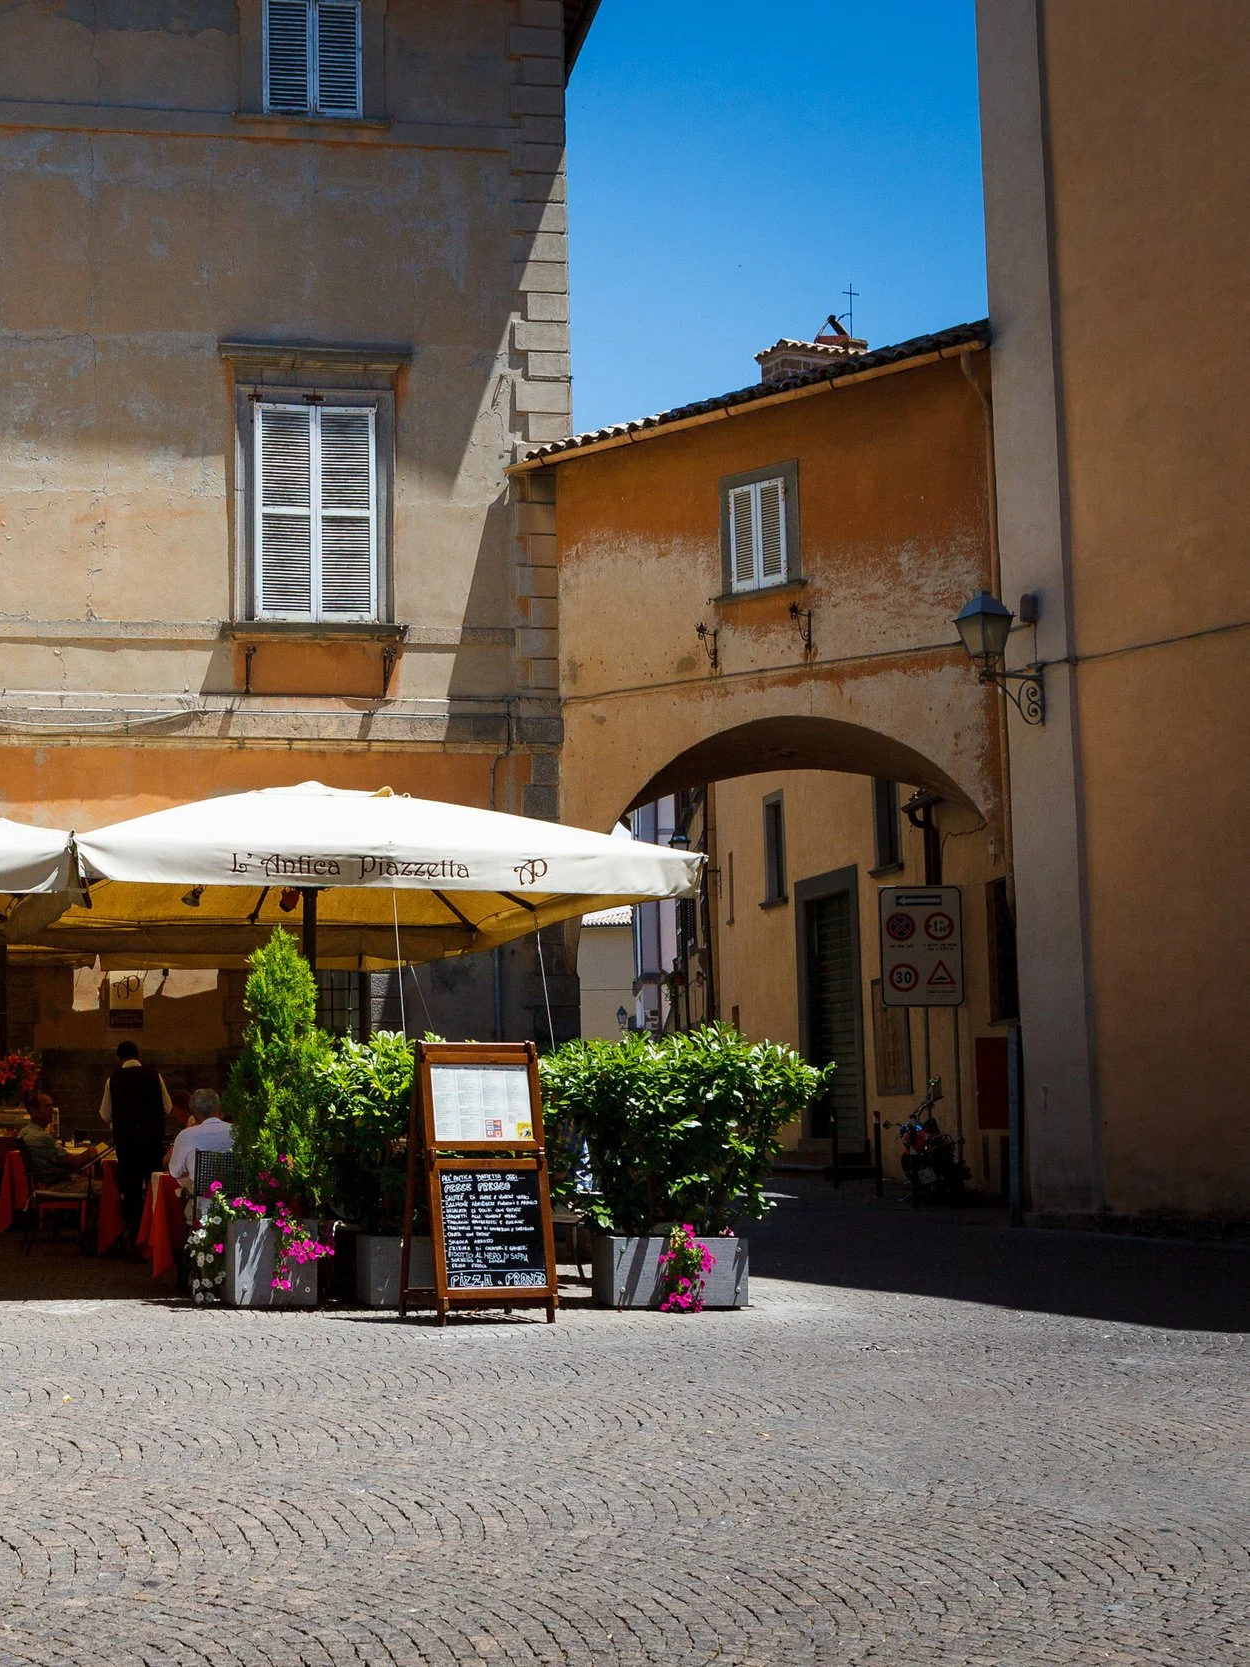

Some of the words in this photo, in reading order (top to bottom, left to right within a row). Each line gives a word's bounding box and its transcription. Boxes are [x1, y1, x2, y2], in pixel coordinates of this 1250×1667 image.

[358, 855, 470, 880] Piazzetta
[895, 971, 913, 984] 30
[444, 1183, 472, 1193] PESCE
[477, 1181, 510, 1191] FRESCO
[505, 1272, 546, 1286] PRANZO
